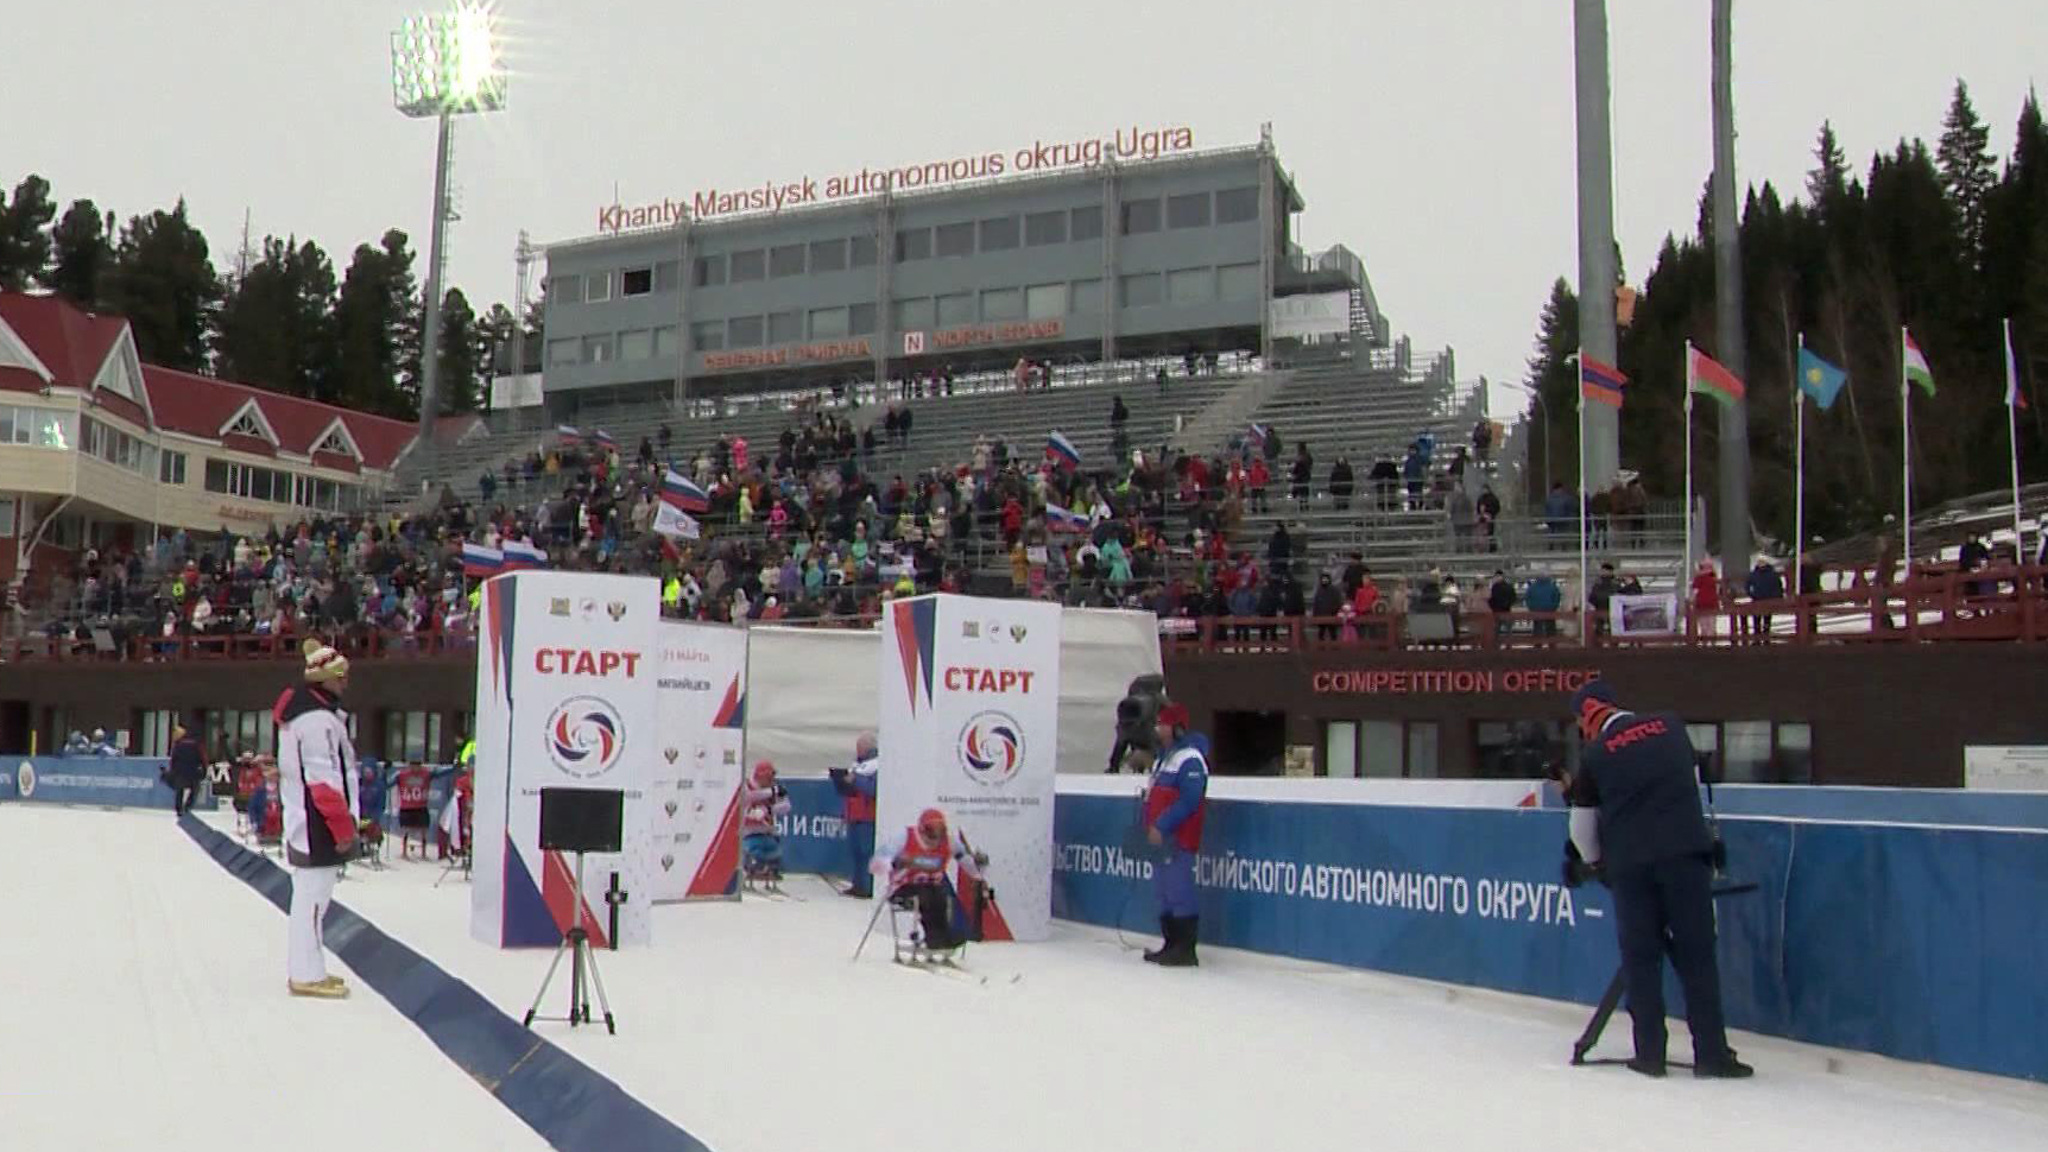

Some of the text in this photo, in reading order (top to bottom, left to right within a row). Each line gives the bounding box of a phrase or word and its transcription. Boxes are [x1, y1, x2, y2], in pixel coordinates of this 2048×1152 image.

[694, 175, 816, 216] Mansiysk
[826, 152, 1005, 198] autonomous
[1015, 140, 1101, 170] okrug
[1115, 126, 1193, 160] Ugra
[536, 648, 642, 678] СТАРТ
[944, 667, 1035, 693] СТАРТ
[1312, 670, 1493, 692] COMPETITION
[793, 814, 807, 836] И
[1300, 863, 1469, 914] АВТОНОМНОГО
[1477, 878, 1576, 926] ОКРУГА
